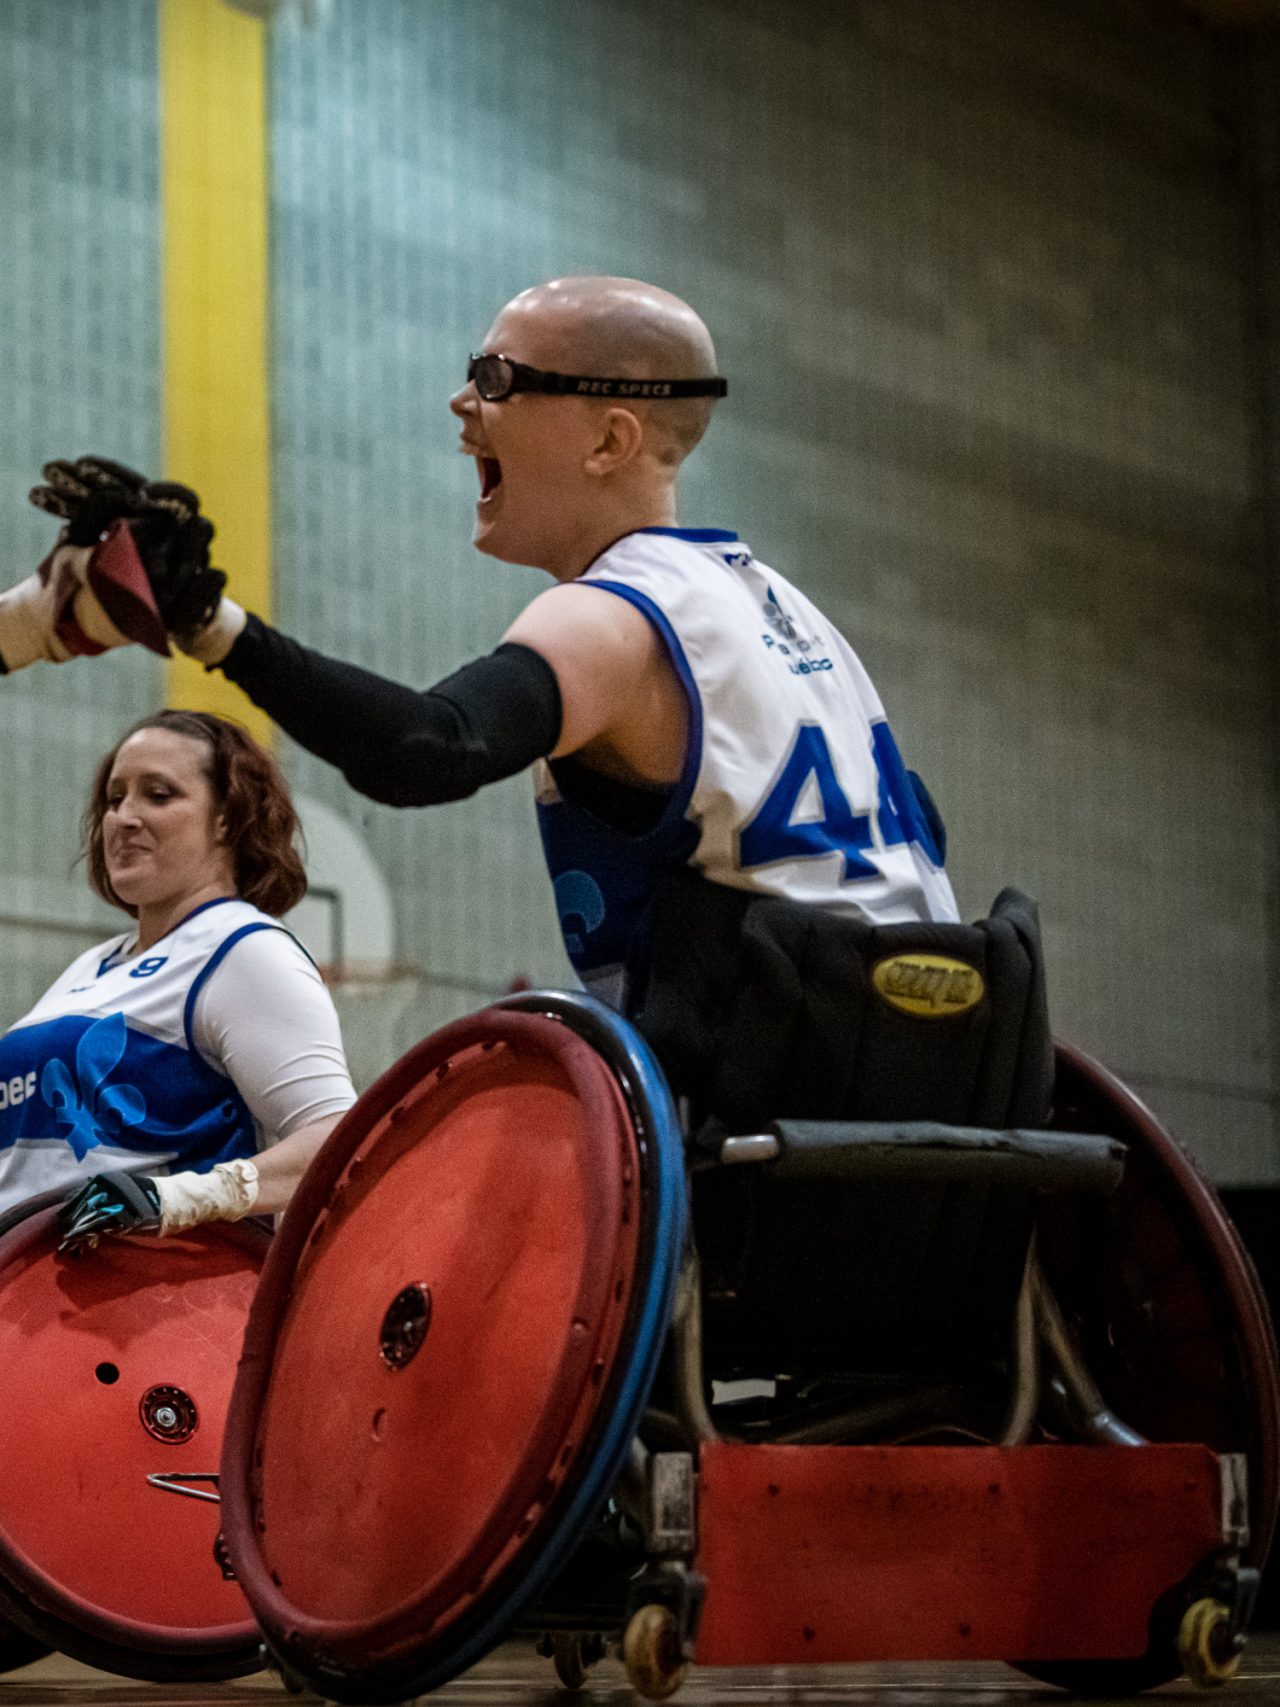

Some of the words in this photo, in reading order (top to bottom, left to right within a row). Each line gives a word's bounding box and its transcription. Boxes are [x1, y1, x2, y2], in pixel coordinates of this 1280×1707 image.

[576, 380, 612, 395] REC
[618, 383, 672, 396] SPECS
[128, 956, 170, 979] 9
